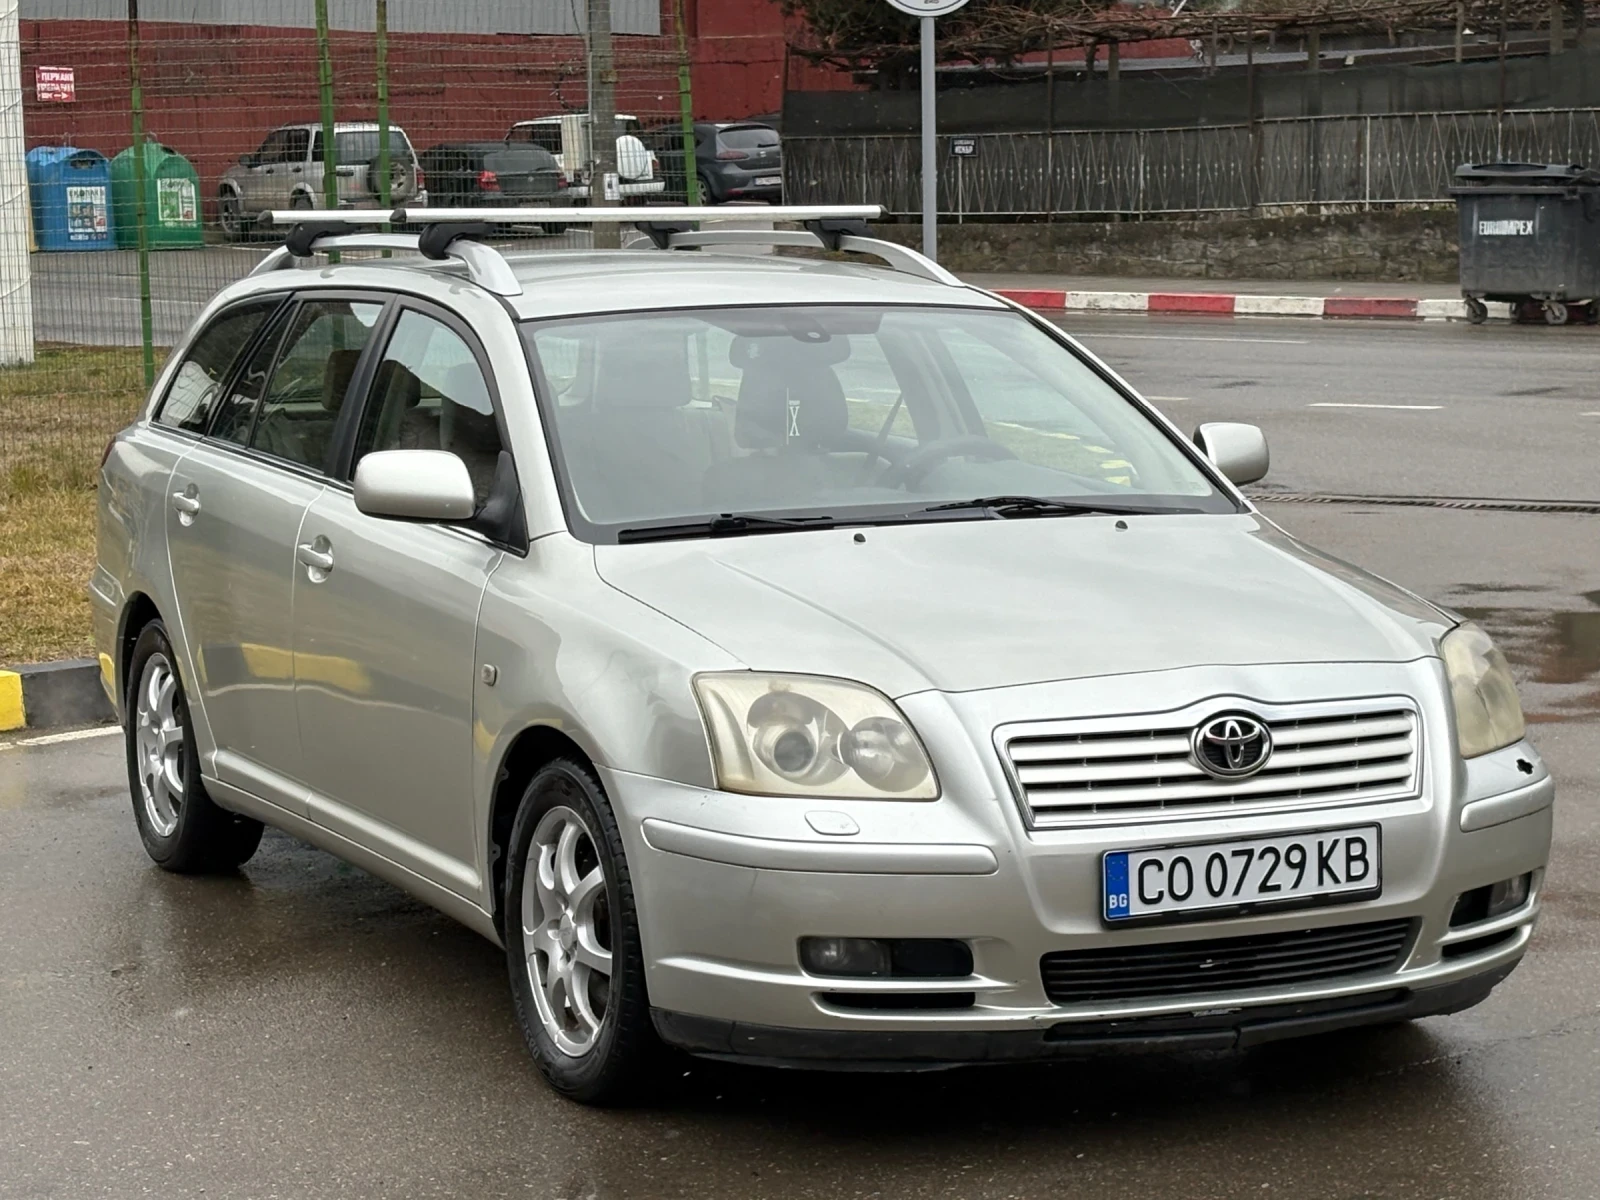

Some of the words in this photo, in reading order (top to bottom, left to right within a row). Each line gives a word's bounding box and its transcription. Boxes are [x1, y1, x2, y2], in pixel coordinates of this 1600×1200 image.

[1137, 855, 1194, 905] CO
[1205, 843, 1307, 898] 0729
[1317, 836, 1370, 887] KB
[1109, 893, 1128, 909] BG
